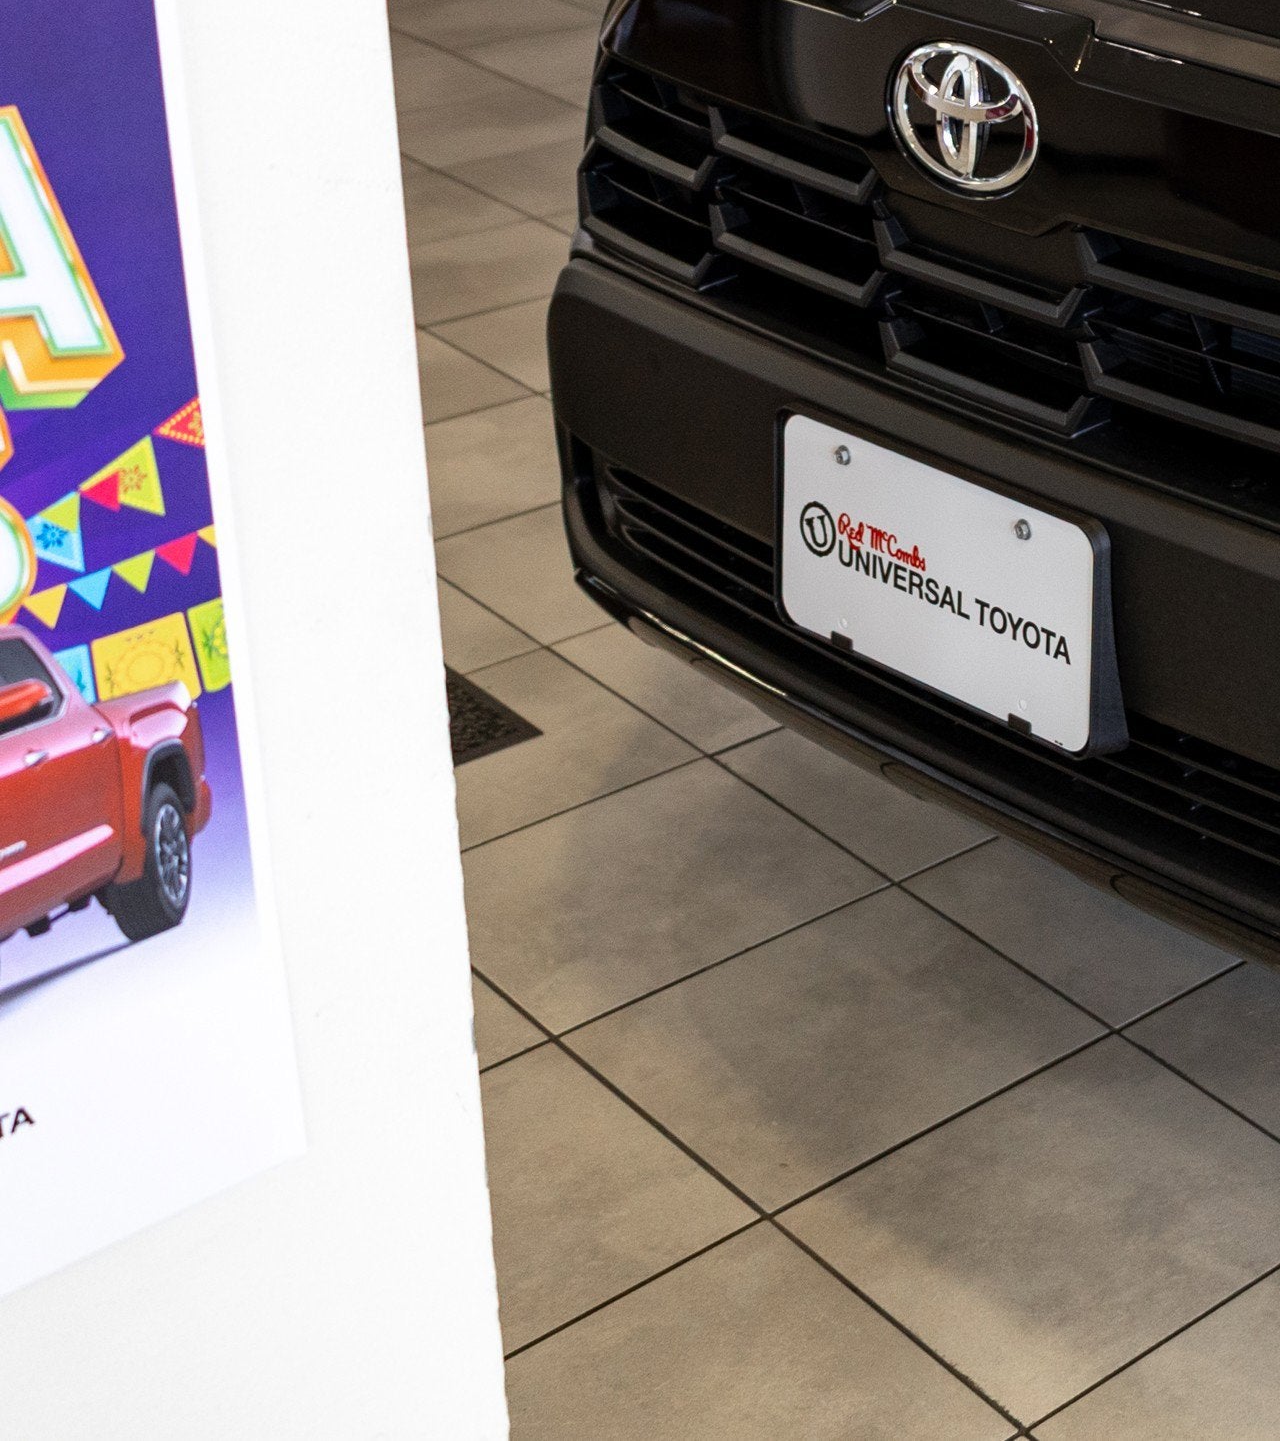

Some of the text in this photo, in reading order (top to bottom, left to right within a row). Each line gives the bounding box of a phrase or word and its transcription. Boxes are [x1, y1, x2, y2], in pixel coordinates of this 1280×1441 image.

[838, 512, 864, 551] Red
[838, 539, 1072, 666] UNIVERSAL TOYOTA
